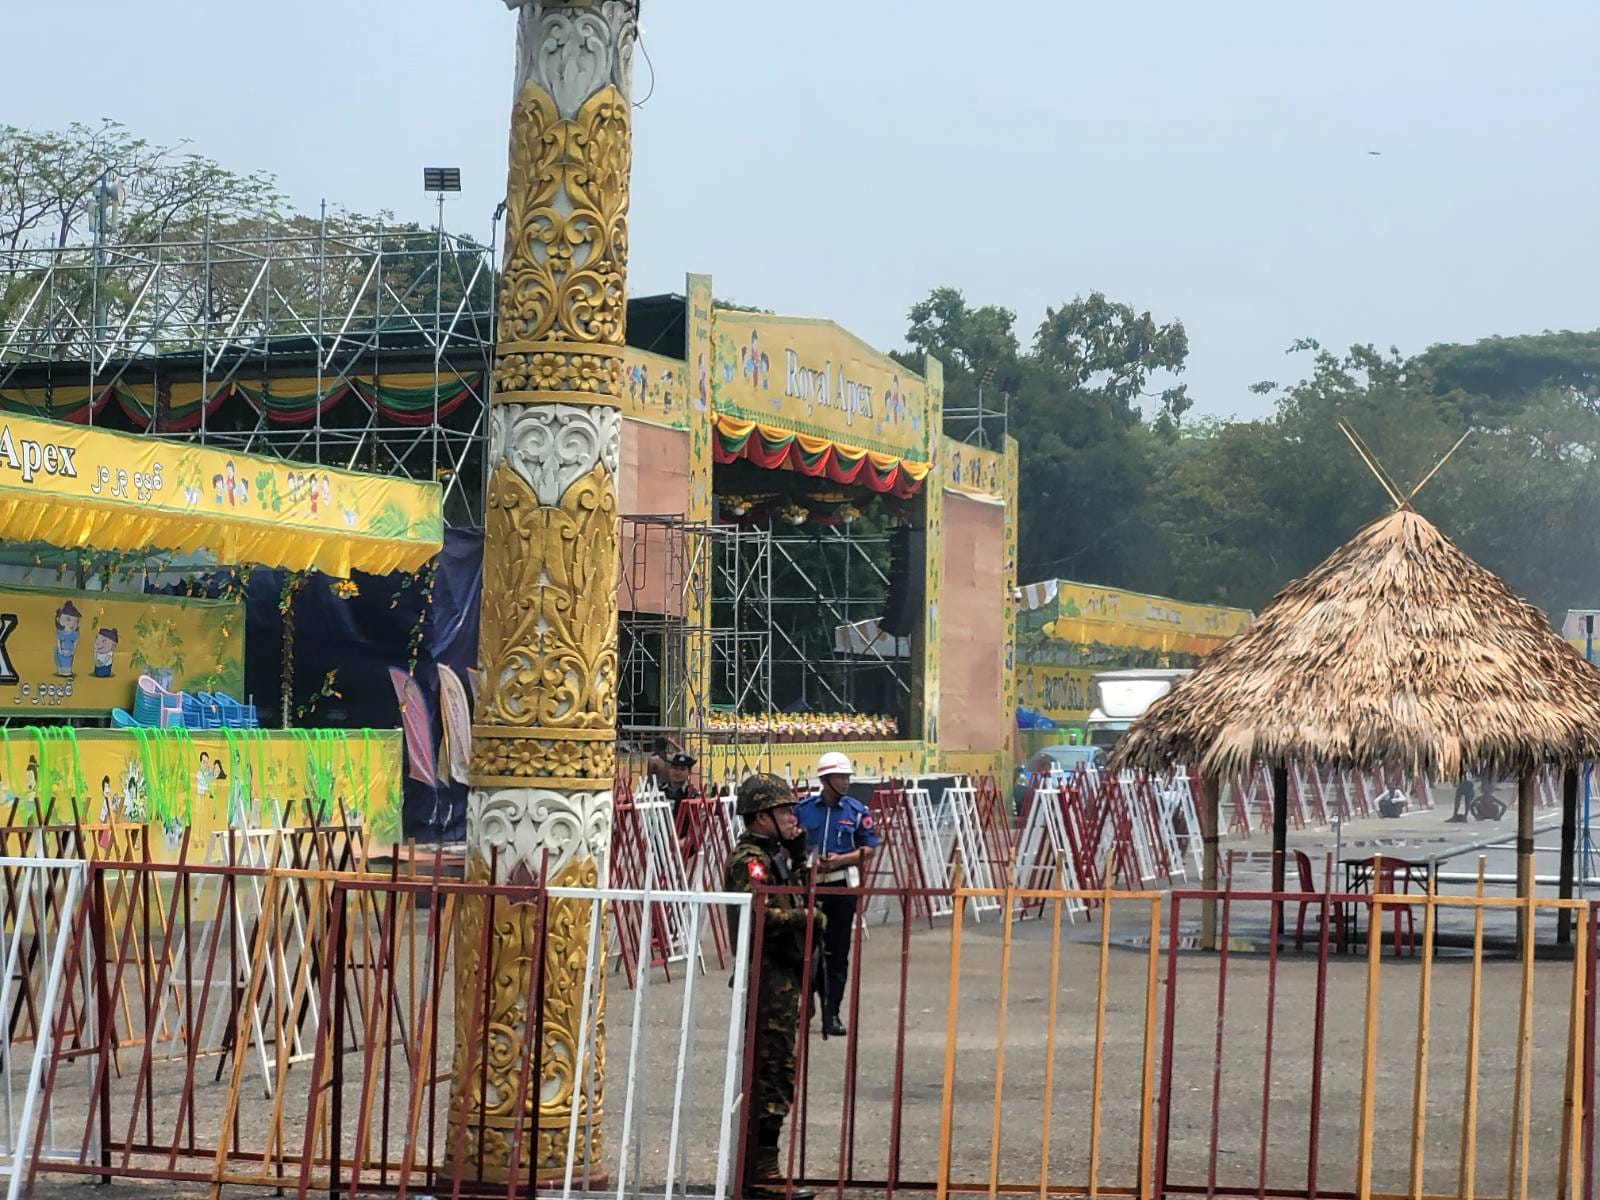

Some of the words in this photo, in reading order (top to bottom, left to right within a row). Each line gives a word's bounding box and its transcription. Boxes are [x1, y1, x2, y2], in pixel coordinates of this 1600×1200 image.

[785, 348, 832, 417] Royal
[834, 364, 873, 427] Apex
[0, 424, 77, 482] Apex
